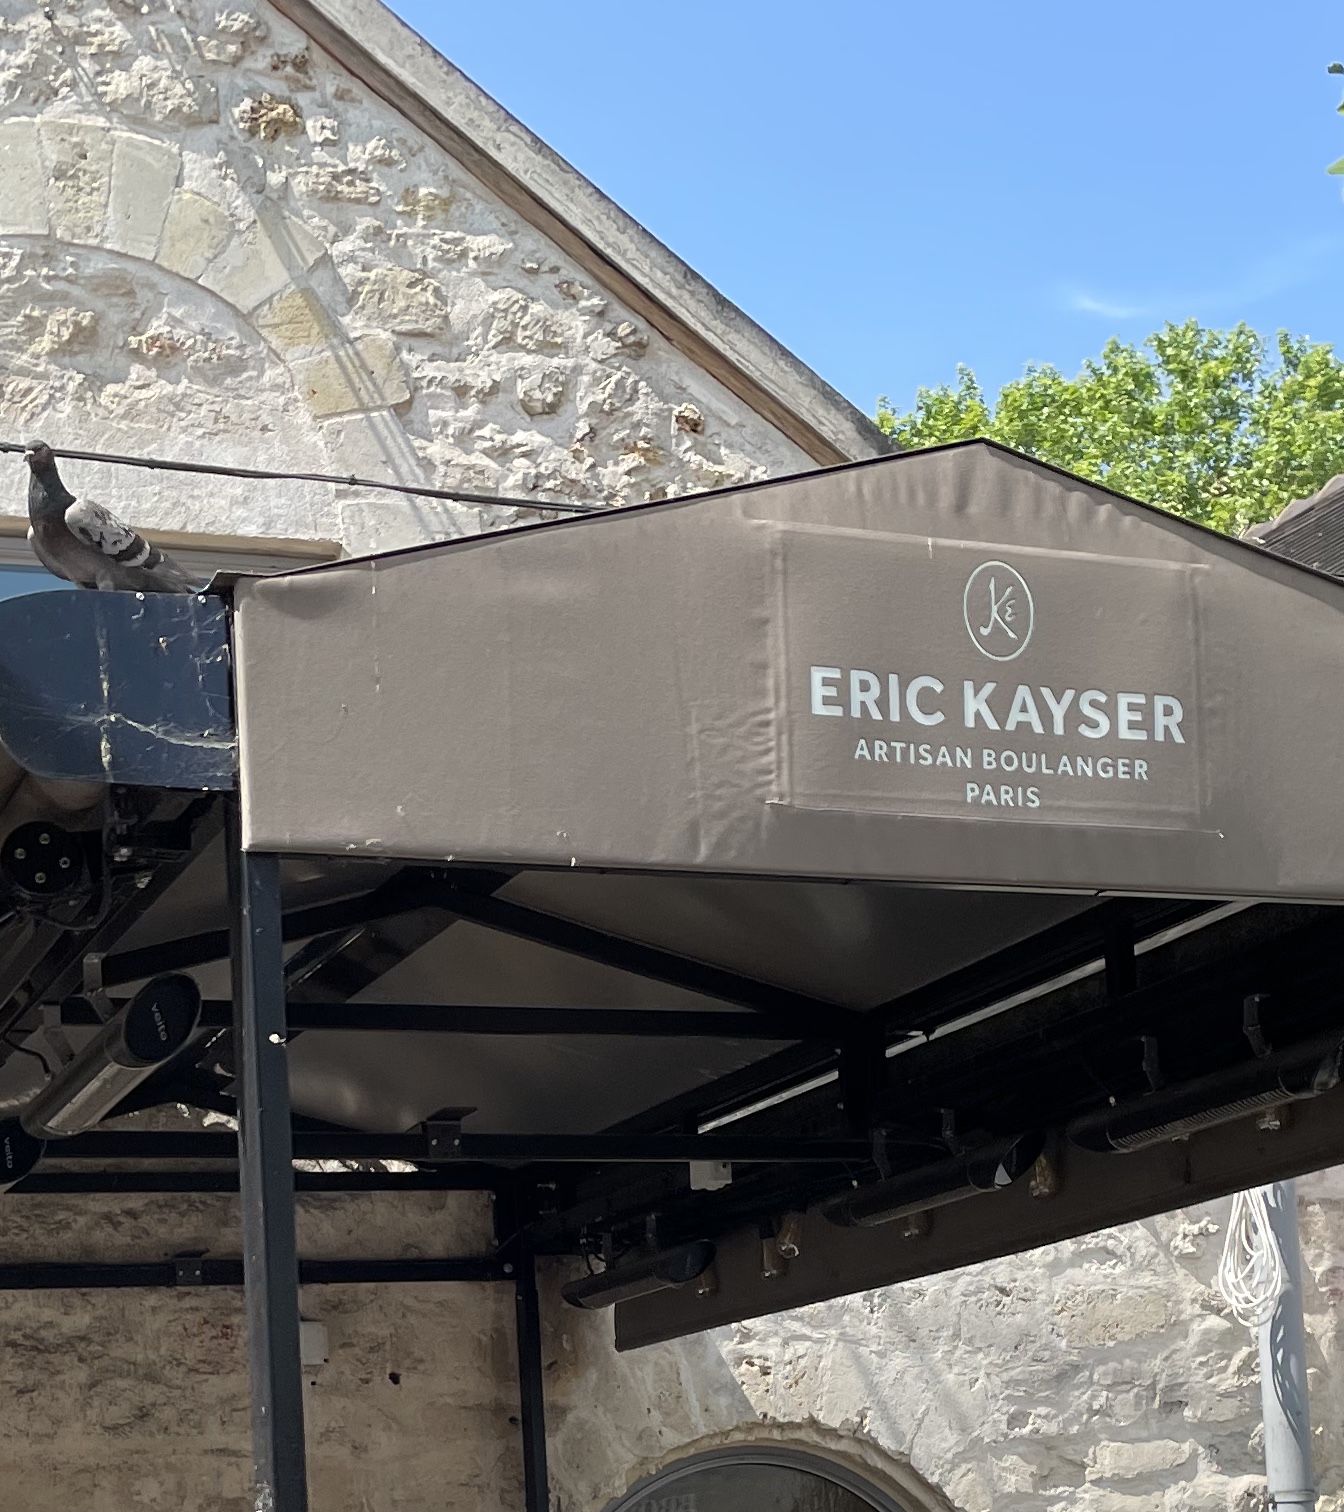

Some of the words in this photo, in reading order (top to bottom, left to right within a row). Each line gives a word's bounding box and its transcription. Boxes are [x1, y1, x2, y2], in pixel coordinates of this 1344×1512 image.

[810, 665, 945, 727] ERIC
[963, 680, 1186, 745] KAYSER
[854, 738, 972, 769] ARTISAN
[982, 748, 1149, 781] BOULANGER
[966, 782, 1040, 808] PARIS
